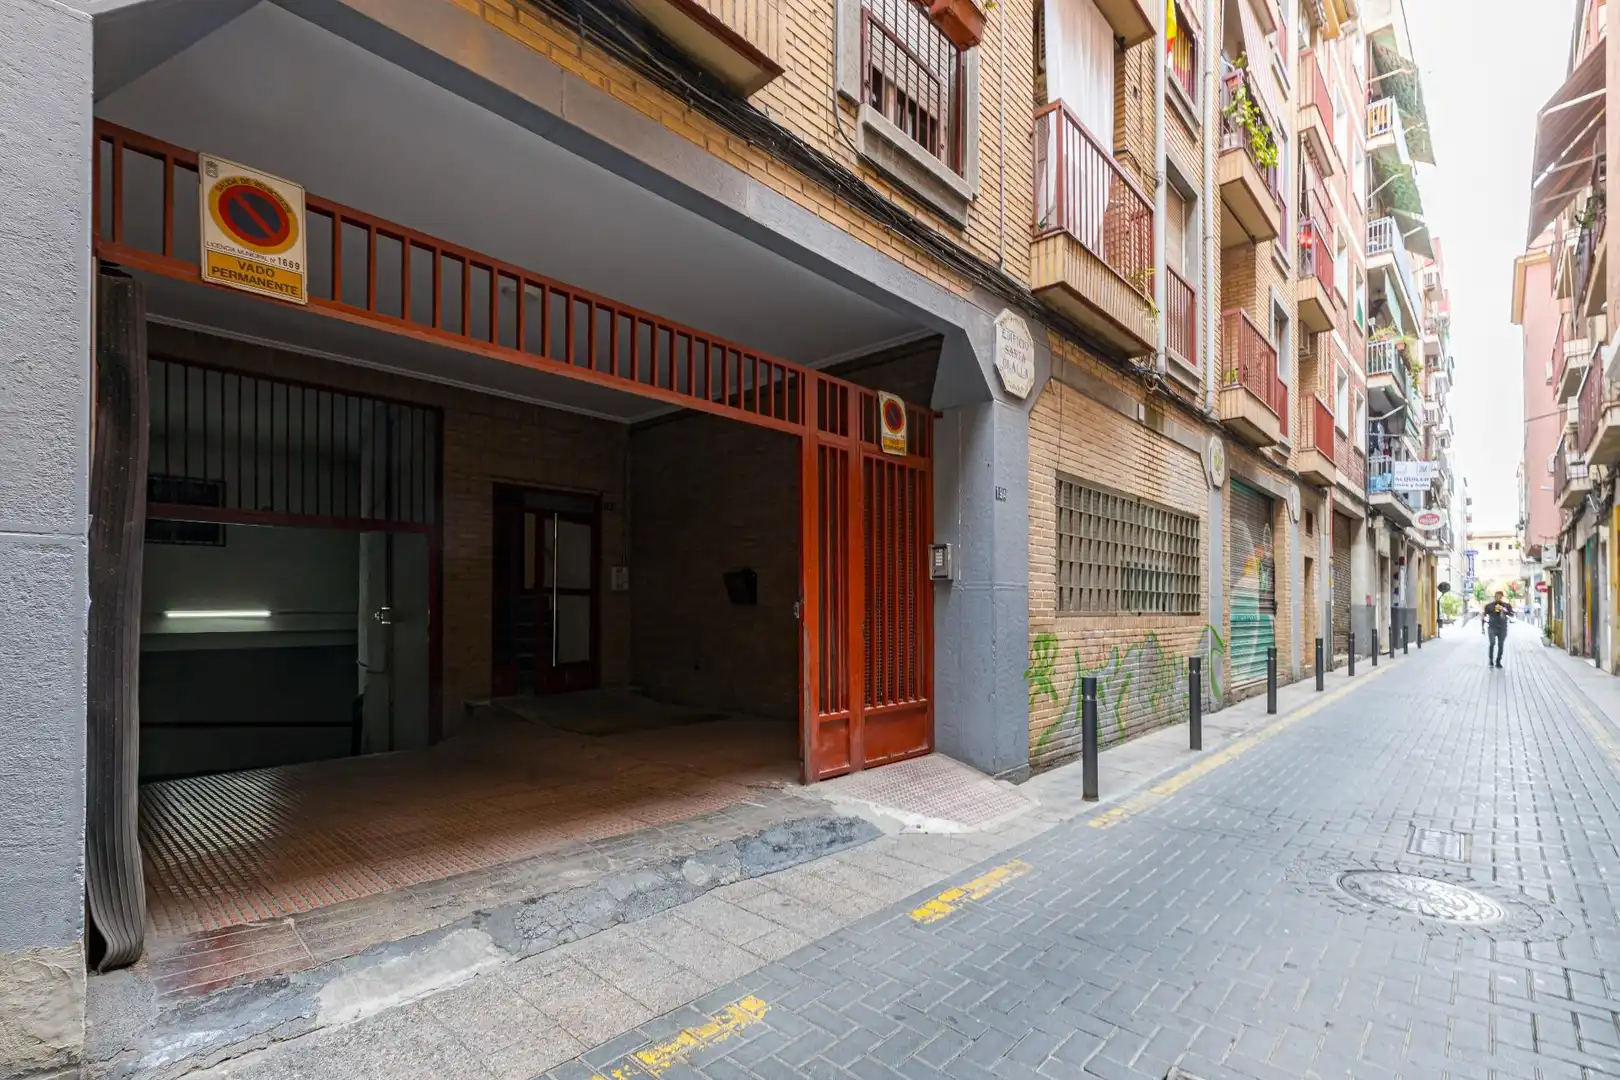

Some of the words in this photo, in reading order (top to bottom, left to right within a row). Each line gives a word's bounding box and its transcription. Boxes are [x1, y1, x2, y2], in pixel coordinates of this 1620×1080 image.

[206, 240, 236, 252] LICENCIA
[236, 248, 268, 261] MUNICIPAL
[237, 260, 275, 278] VADO
[211, 265, 299, 295] PERMANENTE
[1001, 328, 1029, 351] EDIFICIO
[1004, 345, 1026, 364] SANTA
